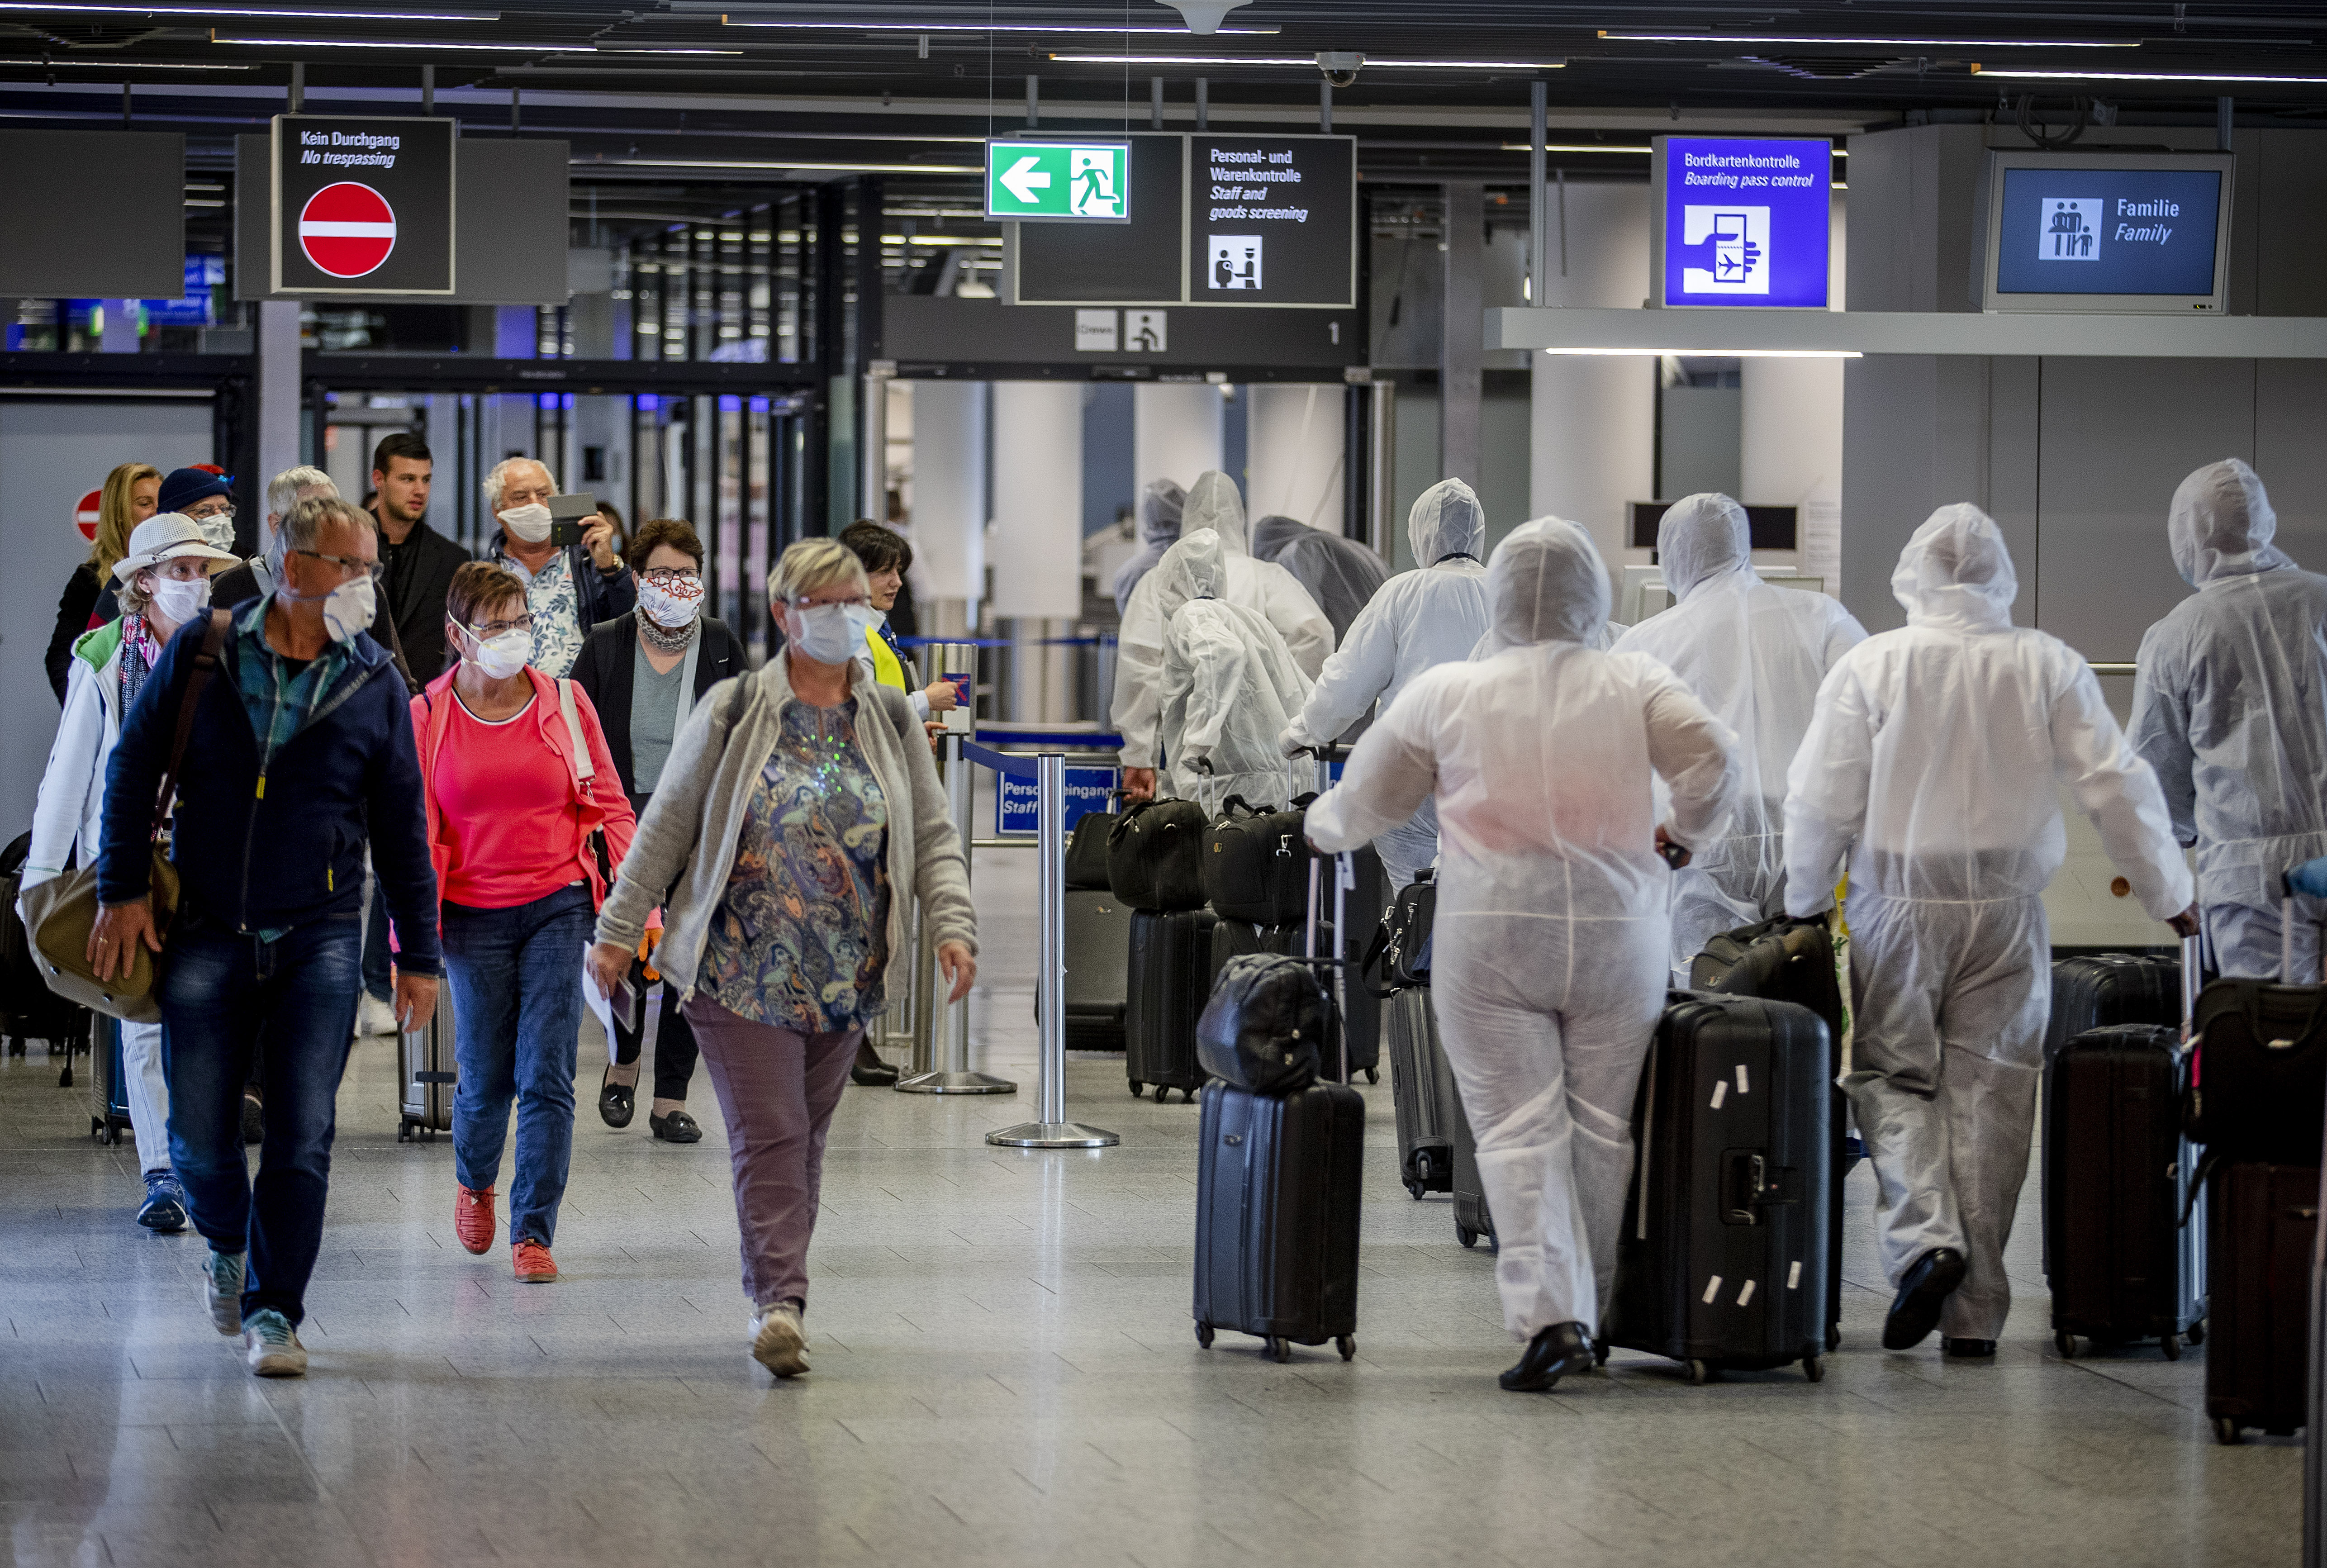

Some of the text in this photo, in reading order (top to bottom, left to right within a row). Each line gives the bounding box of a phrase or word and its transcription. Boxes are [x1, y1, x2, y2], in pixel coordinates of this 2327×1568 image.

[300, 130, 400, 150] Kein Durchgang
[300, 149, 396, 169] No trespassing
[1210, 148, 1292, 164] Personal- und
[1685, 153, 1800, 169] Bordkartenkontrolle
[1209, 166, 1302, 183] Warenkontrolle
[1684, 171, 1814, 189] Boarding pass control
[1209, 185, 1268, 200] Staff and
[1208, 204, 1309, 223] goods screening
[2117, 198, 2180, 218] Familie
[2114, 223, 2173, 246] Family
[1328, 322, 1339, 345] 1
